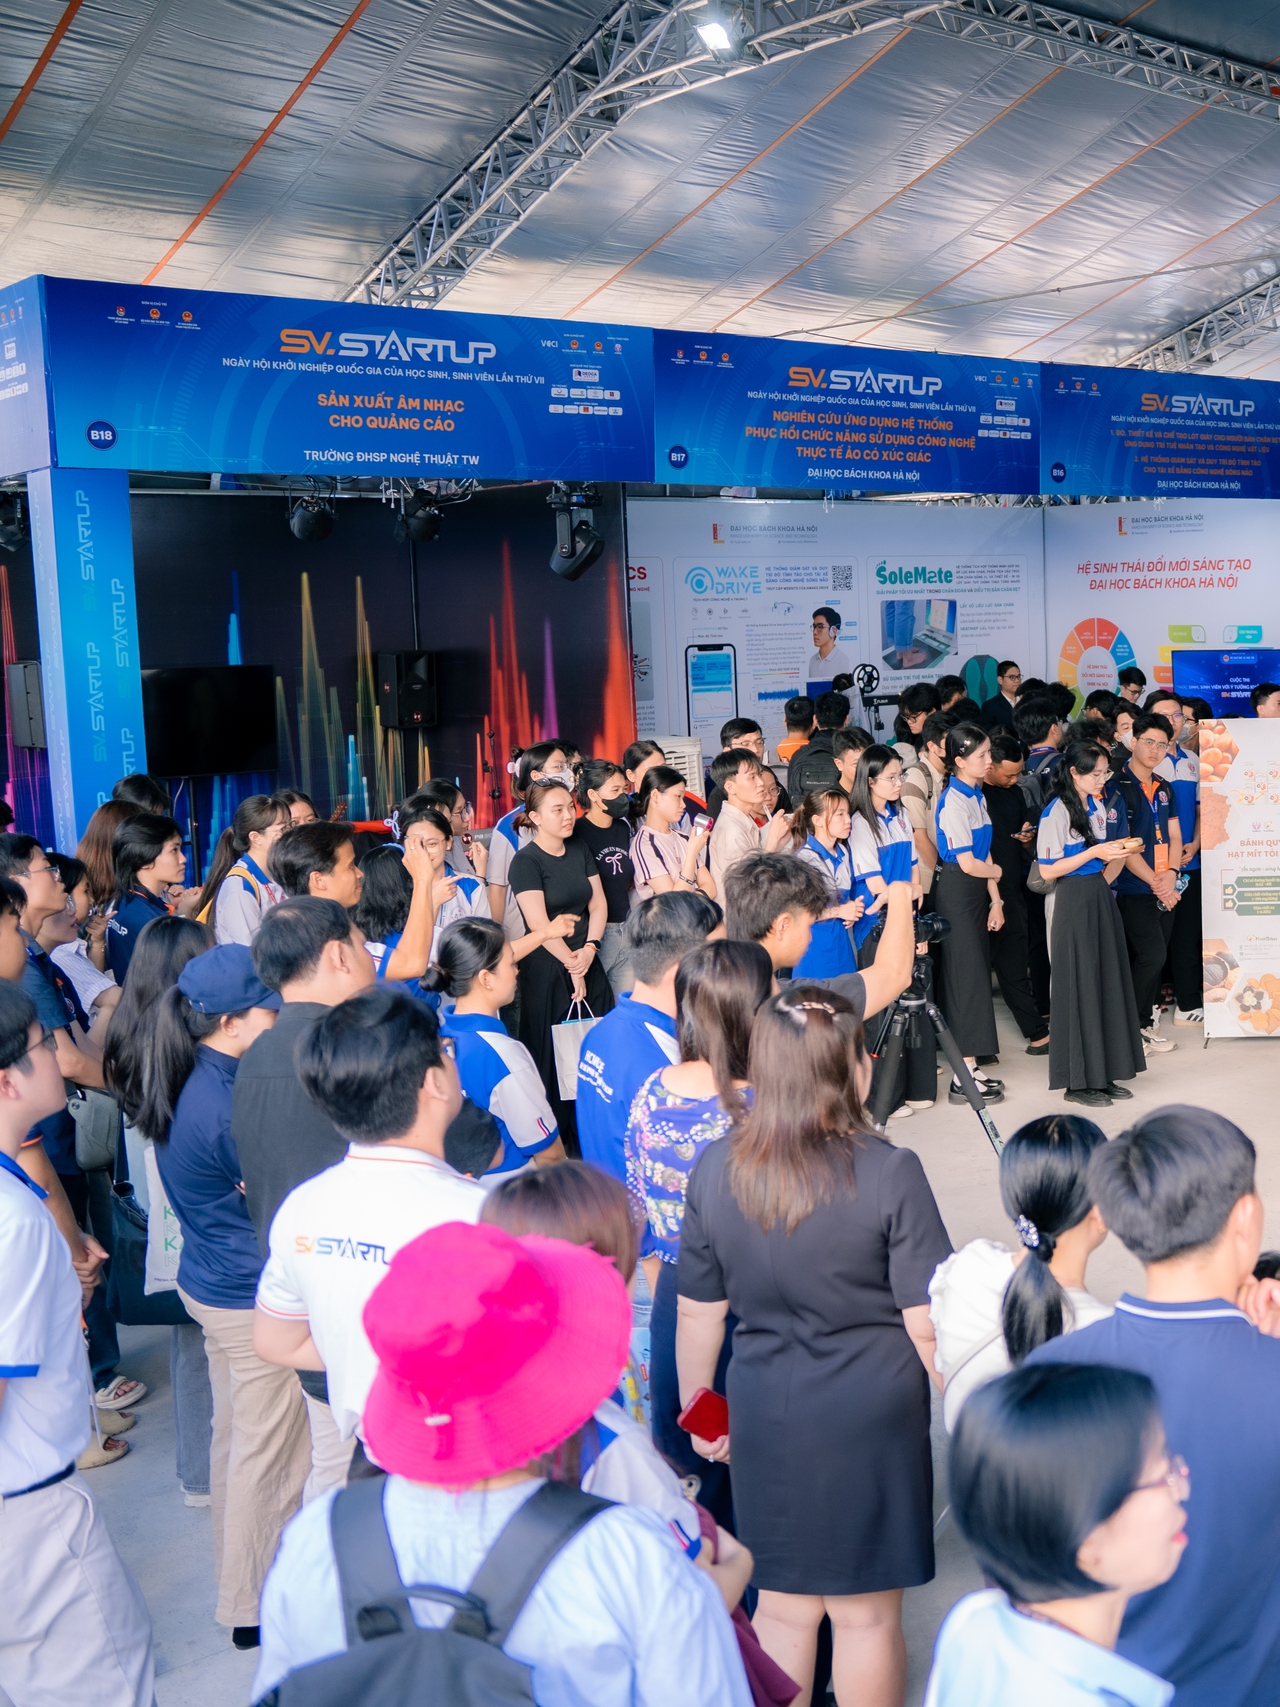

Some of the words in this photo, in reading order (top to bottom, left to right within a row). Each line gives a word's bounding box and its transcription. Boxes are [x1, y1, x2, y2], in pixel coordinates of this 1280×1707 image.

[280, 328, 497, 365] SV.STARTUP
[788, 366, 942, 397] SV.STARTUP
[318, 390, 349, 407] SẢN
[353, 392, 394, 409] XUẤT
[397, 394, 420, 410] ÂM
[424, 399, 464, 415] NHẠC
[1141, 393, 1255, 417] SV.STARTUP
[329, 414, 363, 428] CHO
[366, 413, 420, 430] QUẢNG
[423, 416, 455, 431] CÁO
[91, 430, 113, 441] B18
[304, 449, 354, 461] TRƯỜNG
[356, 452, 387, 462] ĐHSP
[390, 451, 420, 466] NGHỆ
[423, 452, 459, 466] THUẬT
[462, 455, 479, 465] TW
[671, 454, 686, 462] B17
[808, 468, 822, 479] ĐẠI
[824, 469, 842, 479] HỌC
[844, 467, 867, 478] BÁCH
[868, 470, 891, 479] KHOA
[893, 469, 904, 479] HÀ
[906, 470, 919, 482] NỘI
[1077, 560, 1091, 575] HỆ
[1093, 562, 1118, 574] SINH
[1120, 559, 1145, 573] THÁI
[1146, 555, 1167, 573] ĐỔI
[1168, 557, 1191, 572] MỚI
[1192, 556, 1225, 572] SÁNG
[1227, 559, 1252, 573] TẠO
[876, 566, 953, 585] SoleMate
[1090, 579, 1108, 591] ĐẠI
[1108, 579, 1131, 591] HỌC
[1132, 576, 1163, 590] BÁCH
[1164, 577, 1196, 589] KHOA
[1198, 574, 1215, 588] HÀ
[1217, 574, 1239, 589] NỘI
[716, 581, 762, 594] DRIVE
[1240, 838, 1264, 846] BÁNH
[1264, 849, 1278, 857] TỎI
